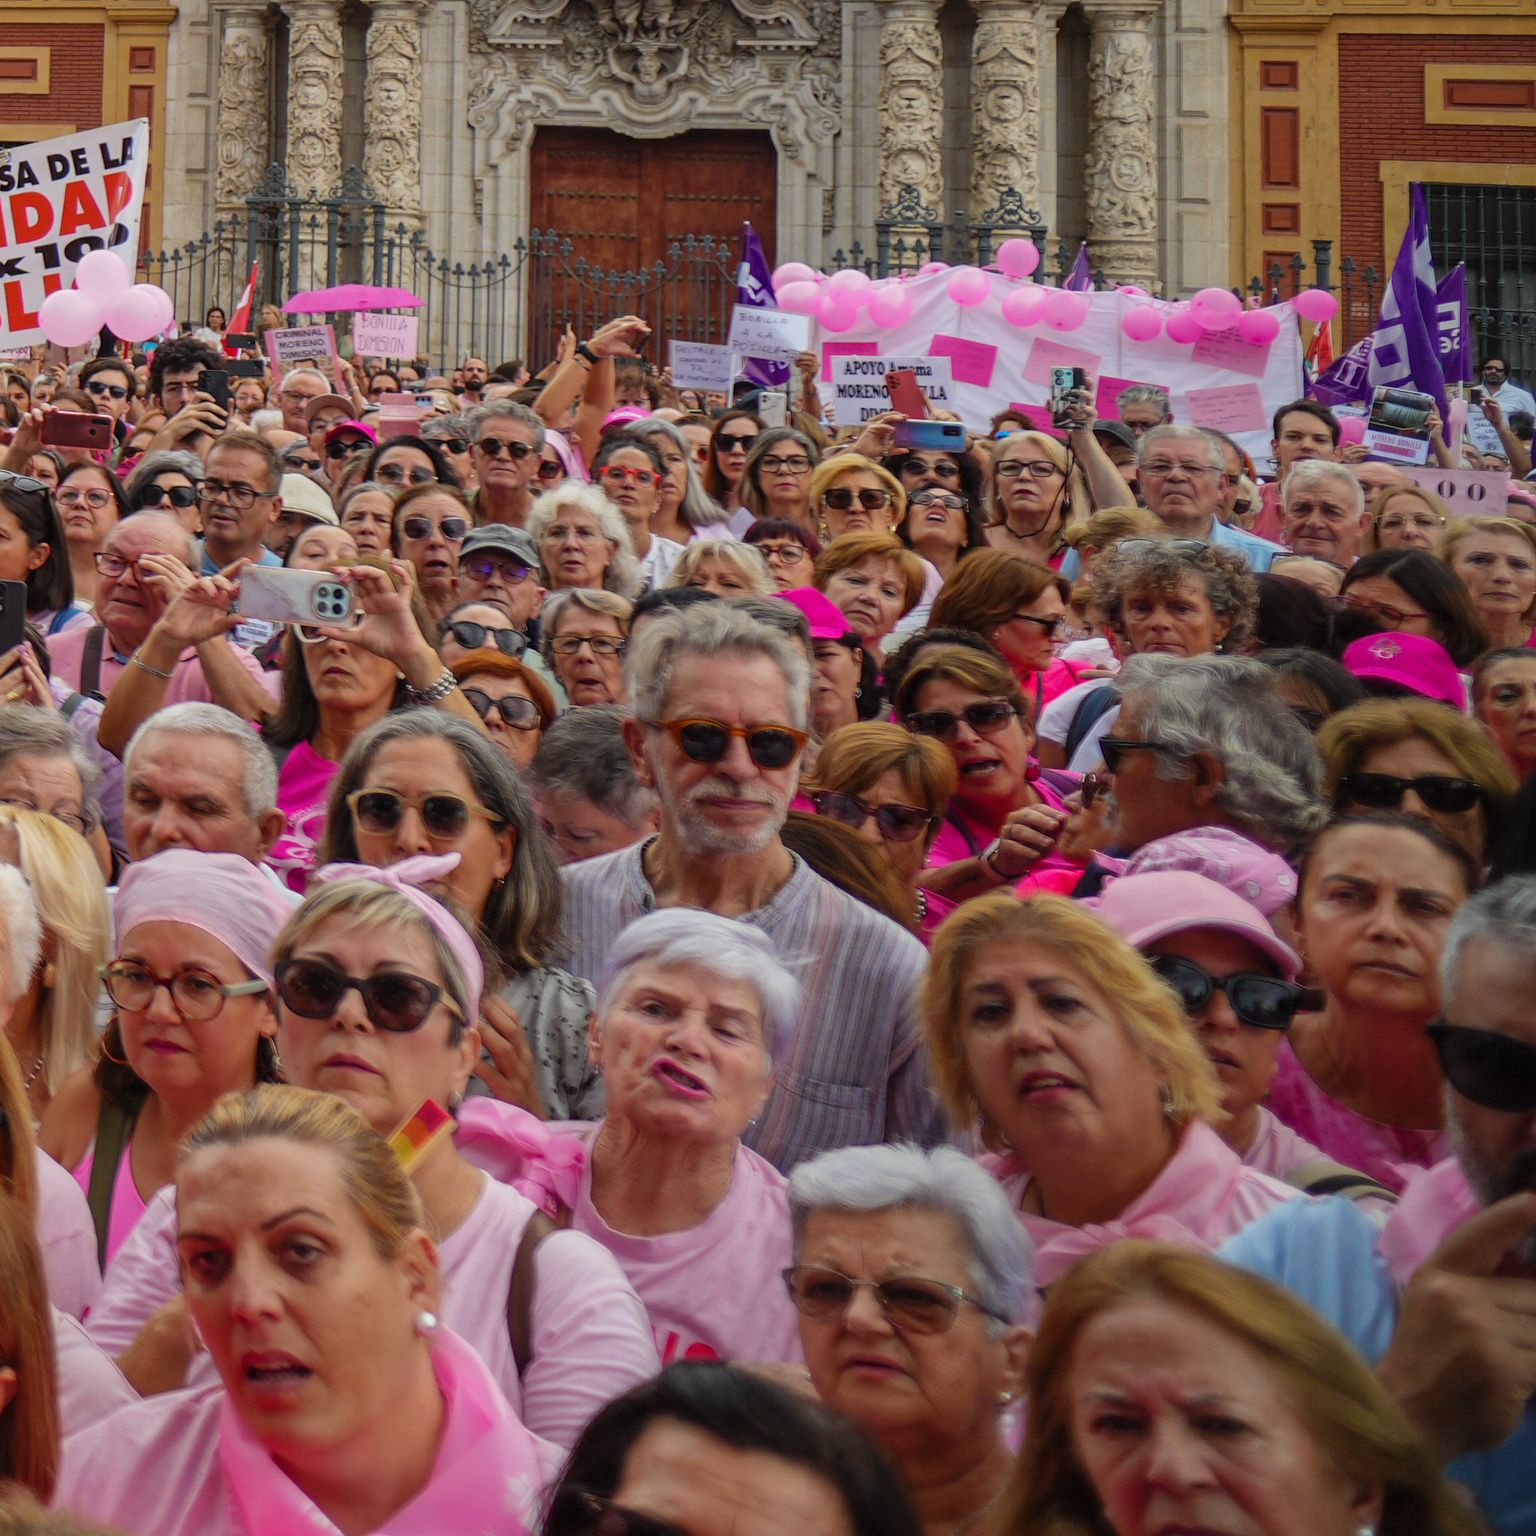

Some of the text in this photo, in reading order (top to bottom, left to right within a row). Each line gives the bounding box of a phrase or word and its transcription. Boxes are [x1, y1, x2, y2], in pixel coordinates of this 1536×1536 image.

[47, 147, 91, 182] DE
[99, 136, 135, 170] LA
[275, 328, 326, 340] CRIMINAL
[279, 338, 325, 349] MORENO
[844, 361, 885, 376] APOYO
[836, 384, 890, 400] MORENO
